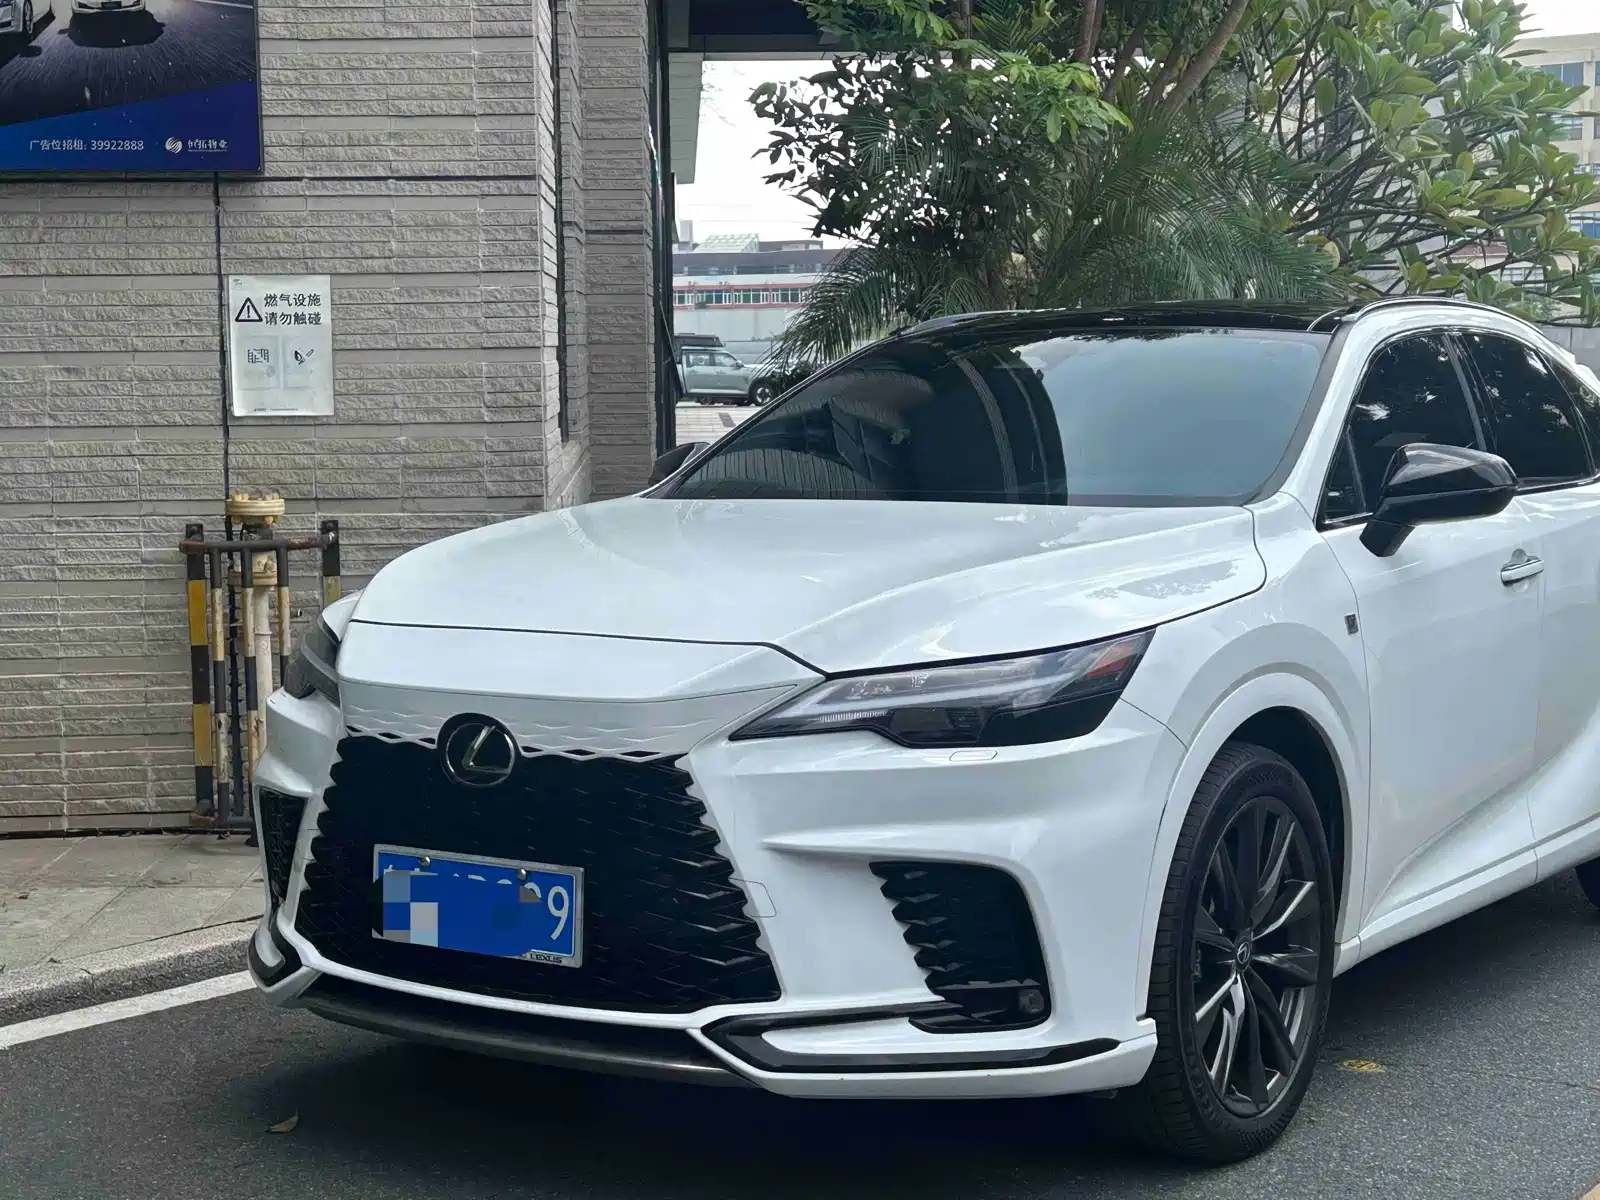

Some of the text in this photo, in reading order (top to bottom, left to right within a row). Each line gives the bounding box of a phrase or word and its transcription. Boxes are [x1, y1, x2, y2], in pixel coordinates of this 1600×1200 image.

[91, 140, 144, 151] 39922888
[264, 293, 322, 307] 燃气设施
[264, 312, 322, 326] 请勿触碰
[530, 953, 563, 964] LEXUS
